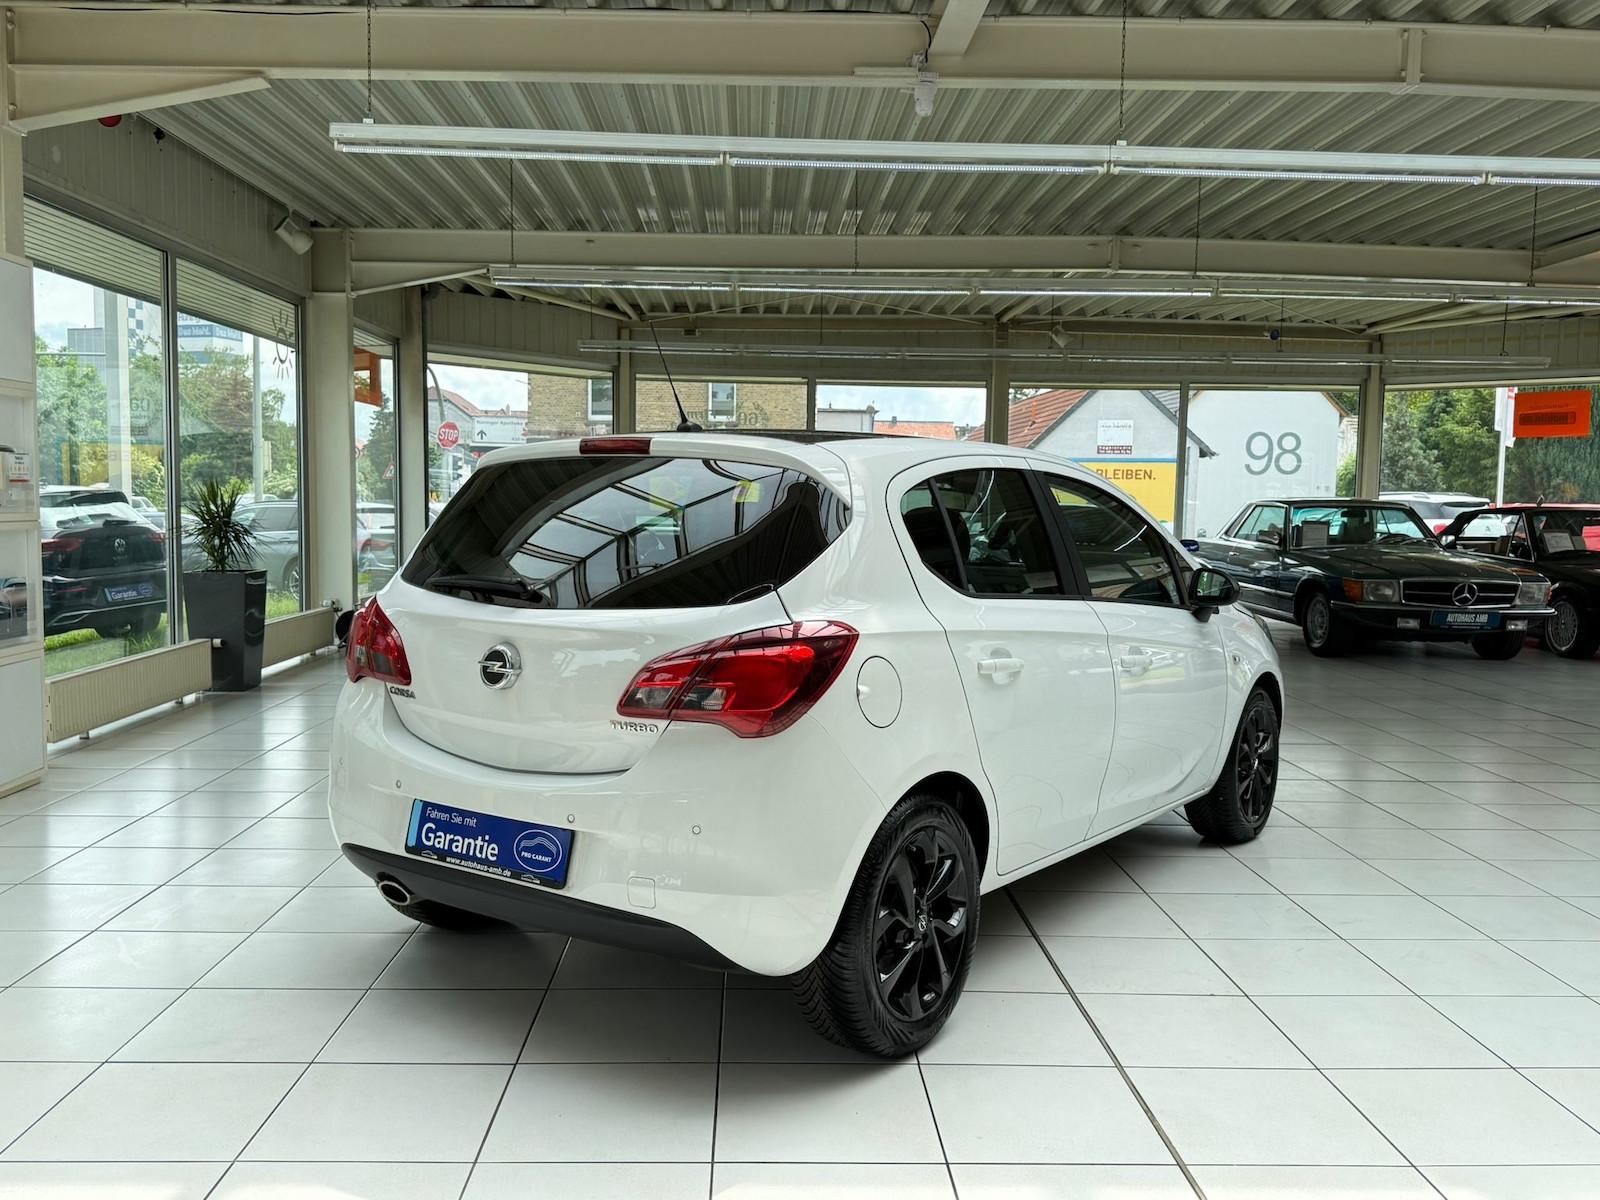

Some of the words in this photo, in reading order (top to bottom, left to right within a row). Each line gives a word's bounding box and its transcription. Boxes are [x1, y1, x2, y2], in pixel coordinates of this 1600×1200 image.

[439, 428, 459, 441] STOP
[1244, 431, 1302, 476] 98
[1446, 613, 1475, 623] AUTOHAUS
[1475, 613, 1489, 623] AMB
[390, 686, 417, 699] CORSA
[610, 719, 659, 734] TURBO
[426, 806, 450, 822] Fahren
[450, 812, 463, 825] Sie
[463, 816, 477, 828] mit
[421, 822, 499, 861] Garantie
[521, 851, 532, 859] PRO
[532, 853, 552, 863] GARANT
[446, 856, 512, 877] www.autohaus-amb.de
